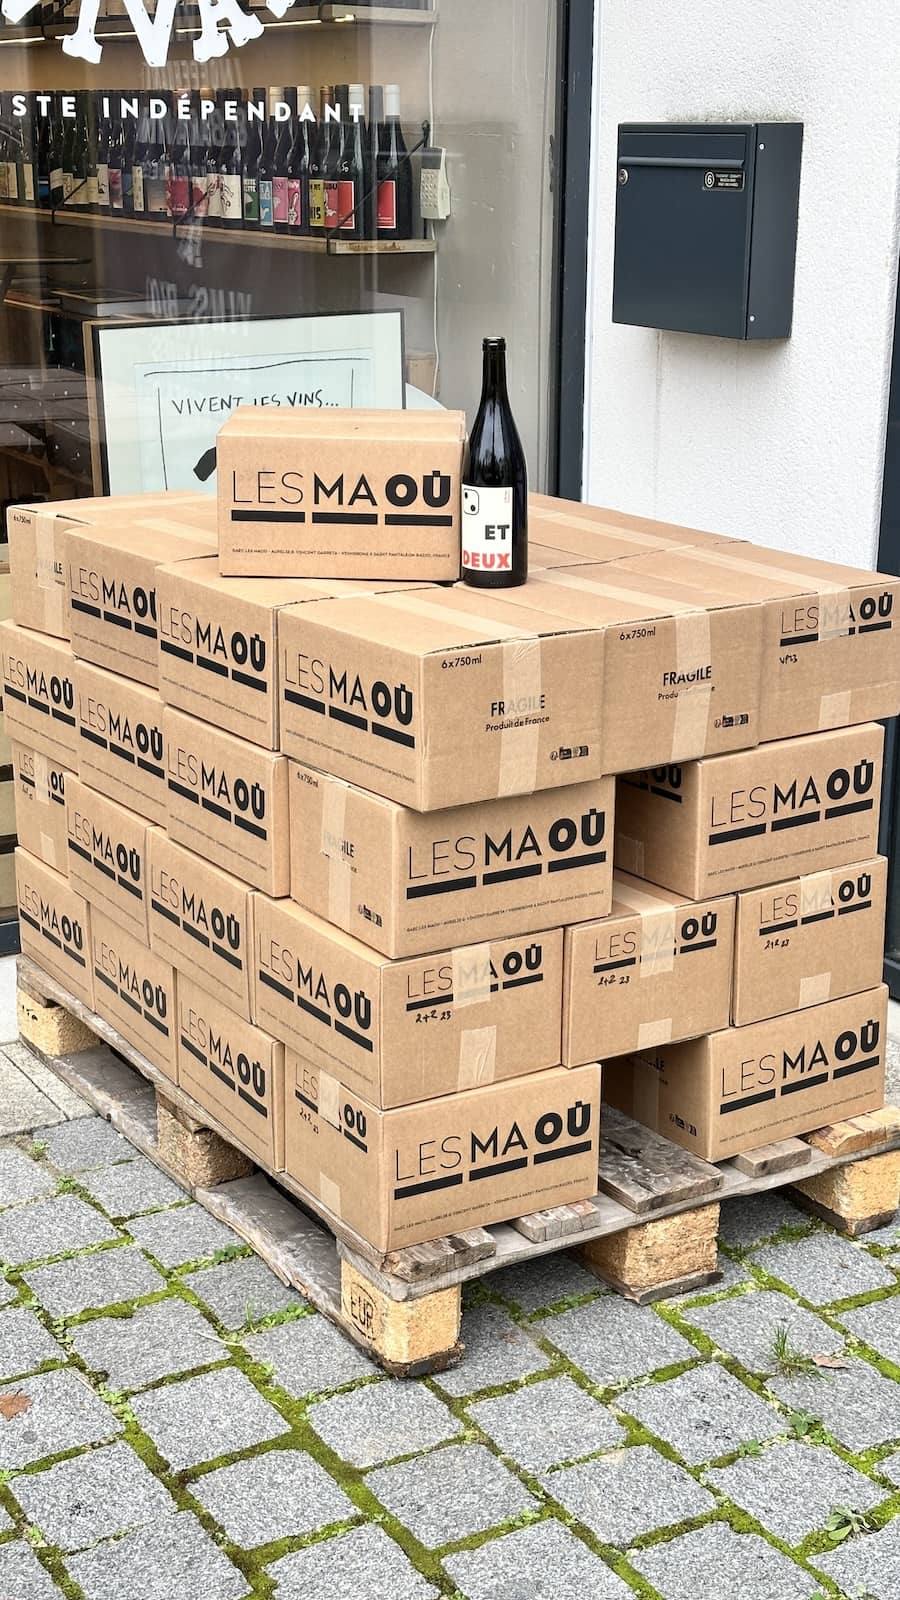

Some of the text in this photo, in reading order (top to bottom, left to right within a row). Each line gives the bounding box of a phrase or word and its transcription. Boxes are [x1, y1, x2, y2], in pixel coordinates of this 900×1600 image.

[0, 93, 362, 122] STE INDÉPENDANT
[172, 395, 243, 415] VIVENT
[286, 389, 339, 408] VINS...
[485, 524, 510, 540] ET
[463, 550, 510, 568] DEUX
[663, 665, 712, 686] FRAGILE
[485, 720, 513, 732] Produit
[525, 716, 550, 727] France
